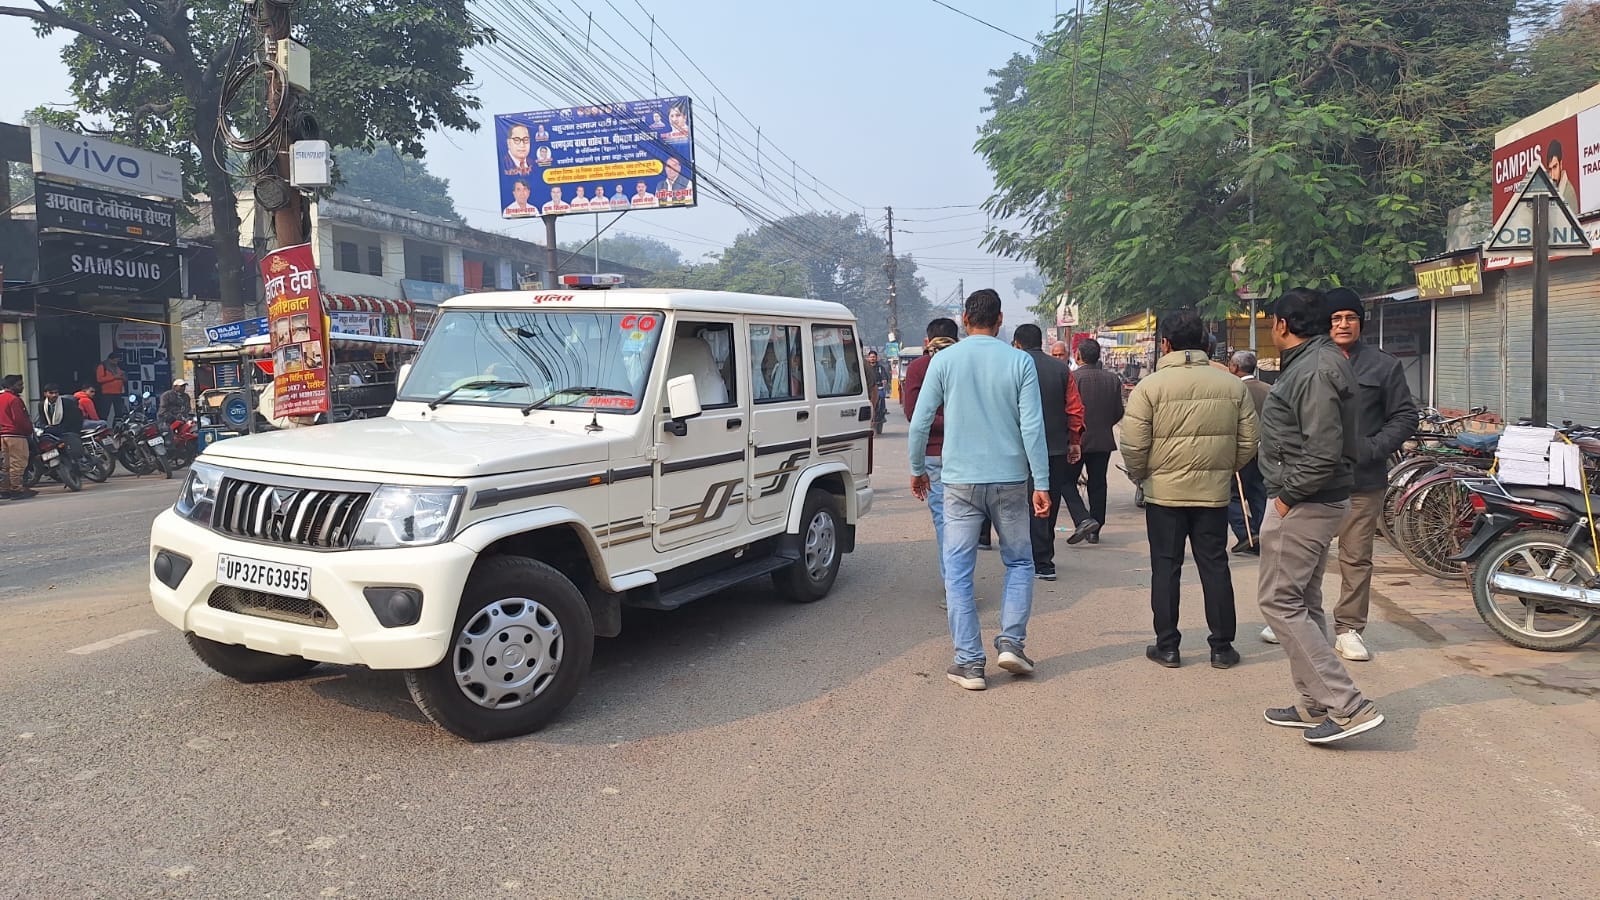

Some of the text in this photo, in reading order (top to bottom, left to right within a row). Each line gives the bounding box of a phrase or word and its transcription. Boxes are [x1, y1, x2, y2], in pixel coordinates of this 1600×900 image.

[55, 141, 140, 179] vivo
[1583, 142, 1600, 158] FAM
[1495, 144, 1542, 185] CAMPUS
[45, 192, 94, 216] अग्रवाल
[1488, 227, 1584, 244] OBND
[71, 254, 161, 280] SAMSUNG
[289, 264, 312, 294] देव
[1417, 269, 1437, 297] कुमार
[532, 293, 575, 304] पुलिस
[620, 315, 656, 332] CO
[226, 560, 309, 591] UP32FG3955
